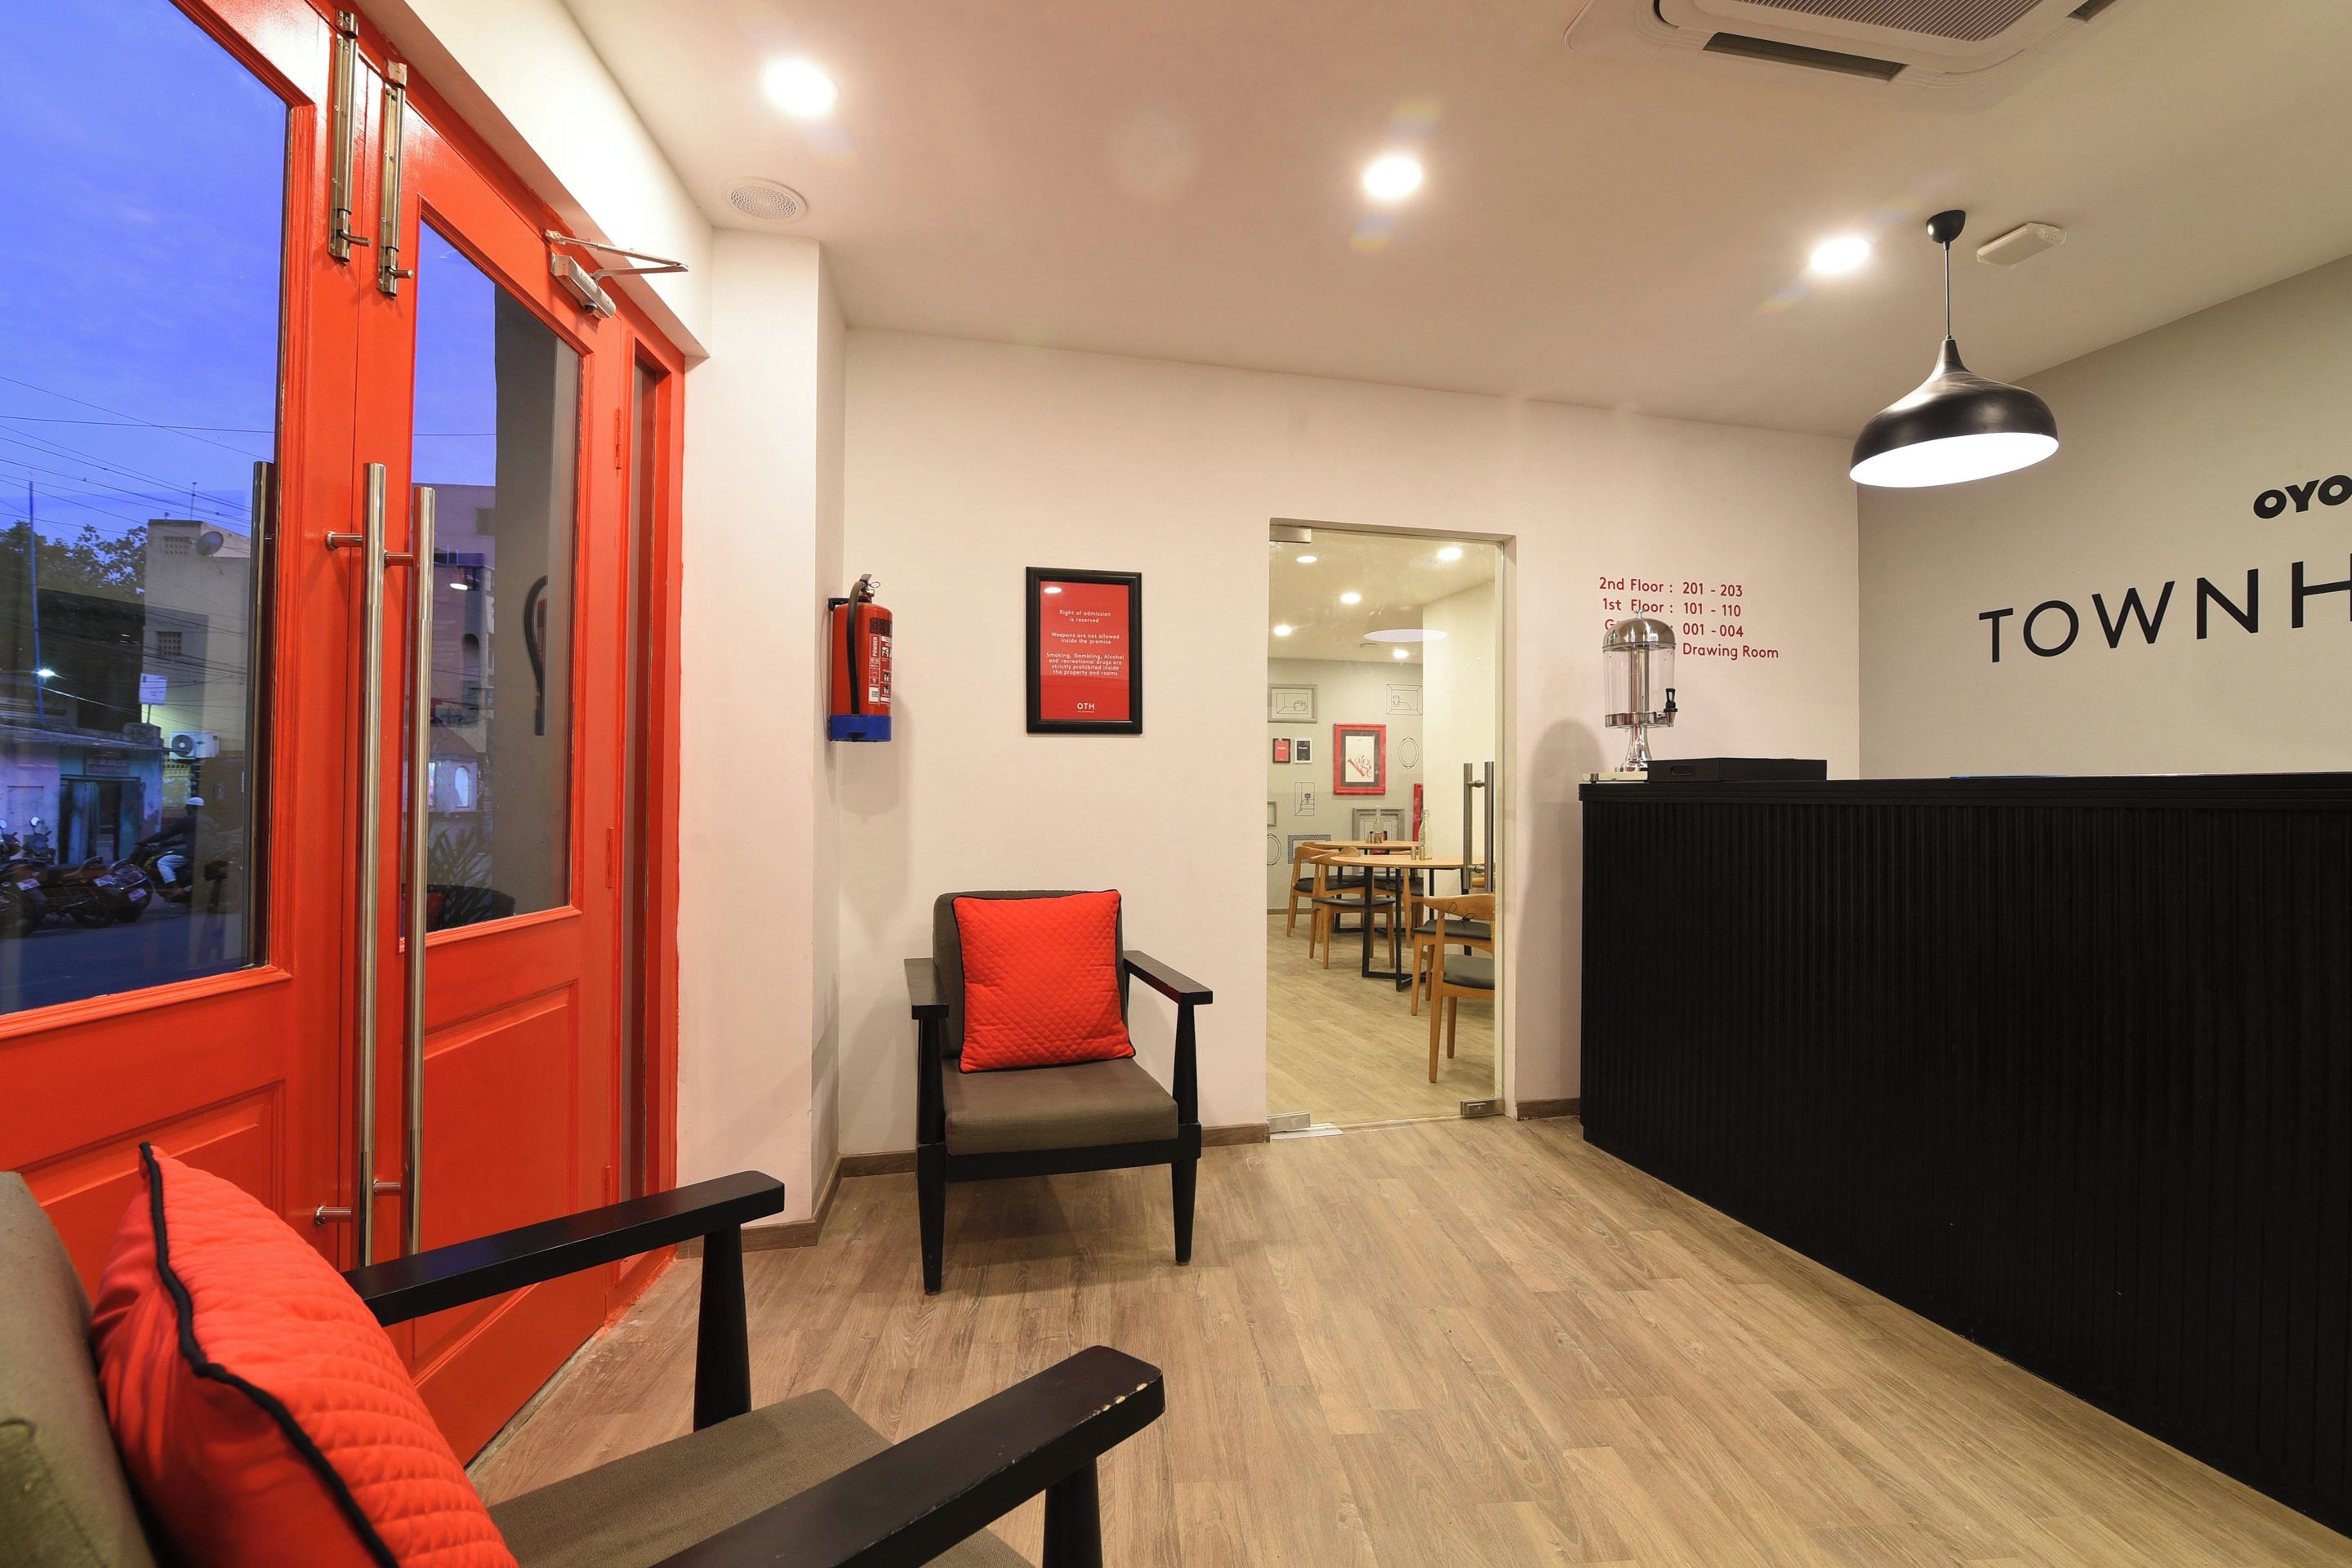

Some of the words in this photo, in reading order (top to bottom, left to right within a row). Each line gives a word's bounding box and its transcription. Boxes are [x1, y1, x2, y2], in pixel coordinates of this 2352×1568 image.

[2253, 474, 2352, 519] OYO
[1599, 577, 1624, 590] 2nd
[1630, 578, 1664, 592] Floor
[1682, 581, 1704, 595] 201
[1720, 584, 1743, 597] 203
[1602, 597, 1622, 611] 1st
[1631, 599, 1664, 612] Floor
[1683, 603, 1704, 614] 101
[1722, 604, 1741, 617] 110
[1979, 553, 2352, 662] TOWNH
[1682, 623, 1704, 635] 001
[1719, 625, 1744, 638] 004
[1682, 643, 1738, 661] Drawing
[1743, 645, 1779, 658] Room
